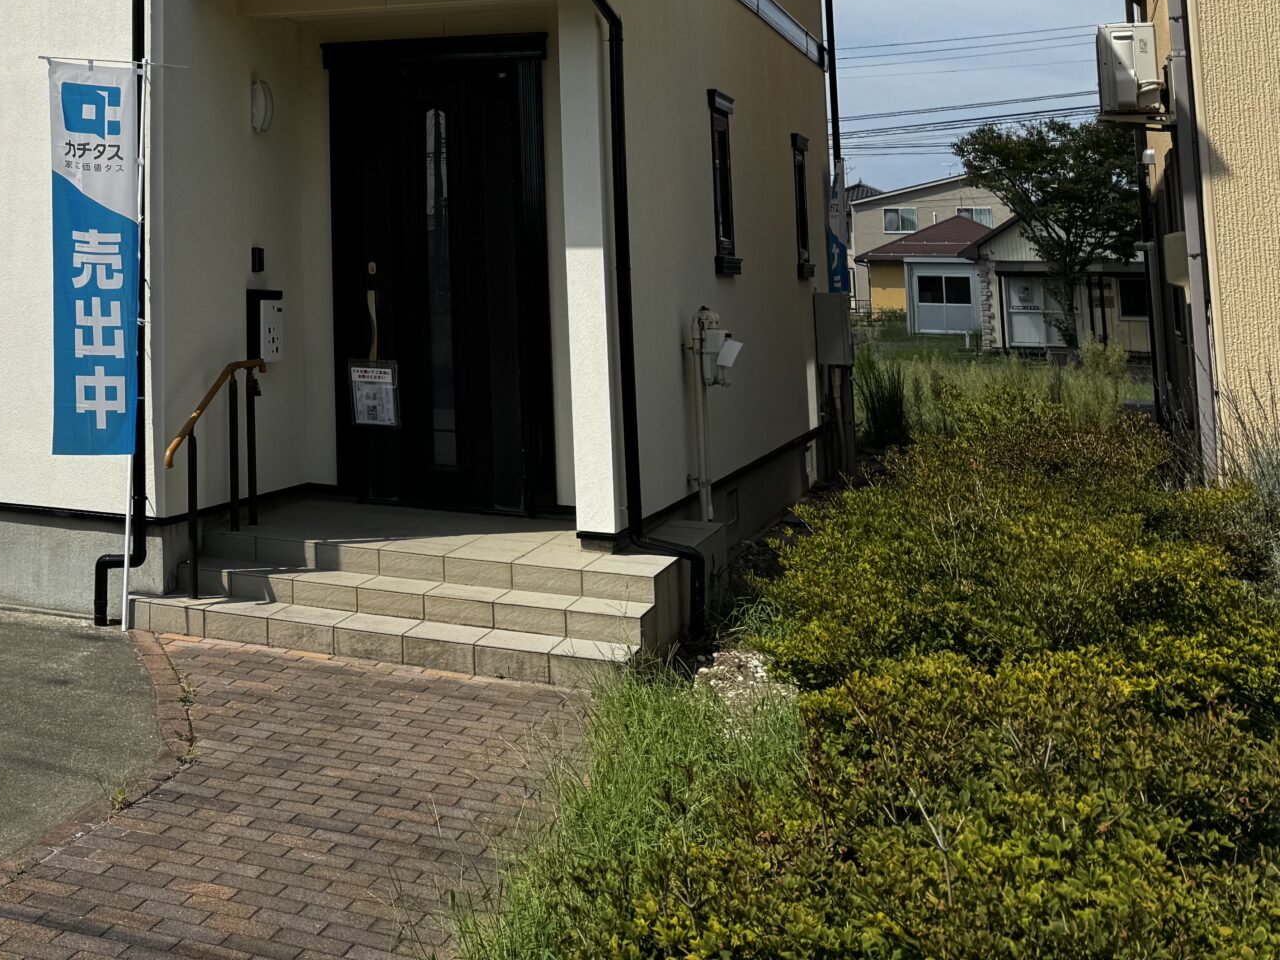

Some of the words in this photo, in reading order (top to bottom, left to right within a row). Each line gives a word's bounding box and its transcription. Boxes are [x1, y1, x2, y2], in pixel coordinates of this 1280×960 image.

[64, 140, 124, 160] カチタス
[72, 229, 126, 429] 売出中
